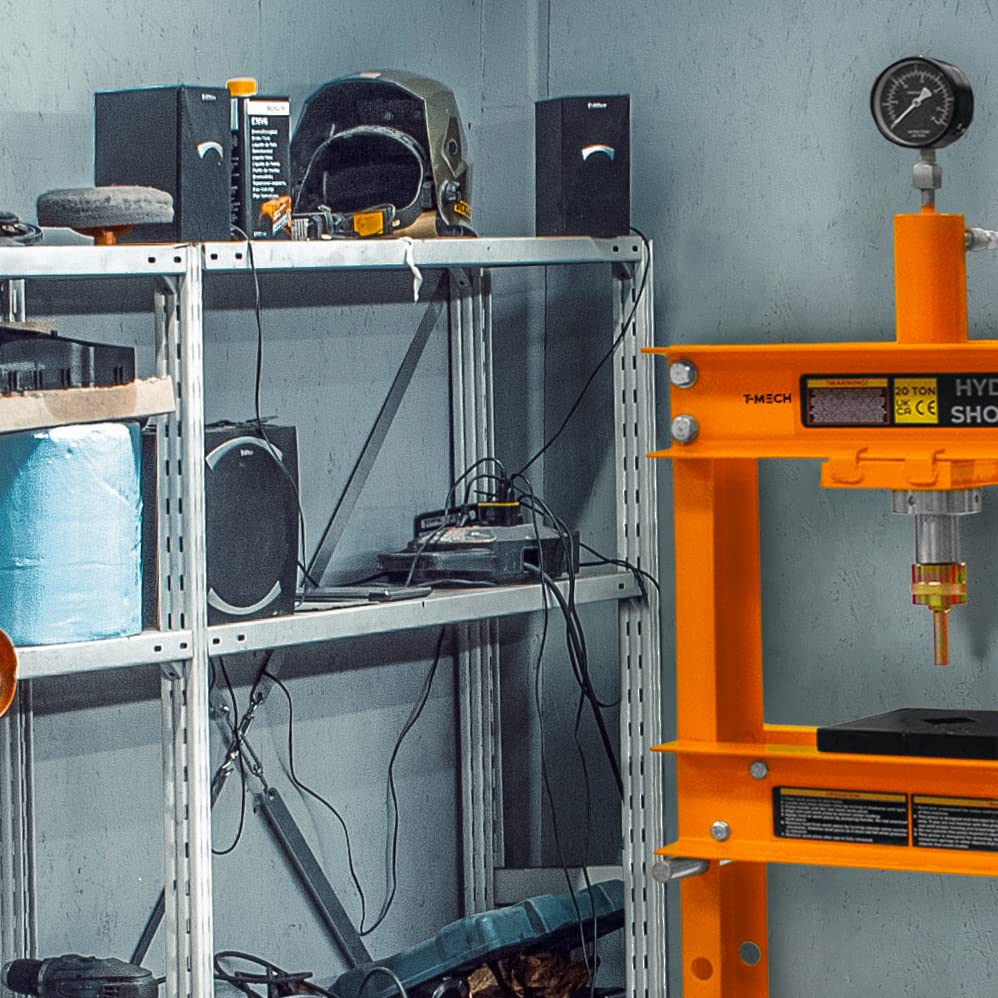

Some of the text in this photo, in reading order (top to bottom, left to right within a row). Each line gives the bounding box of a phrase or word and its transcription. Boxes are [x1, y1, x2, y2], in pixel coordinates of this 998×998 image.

[895, 386, 936, 396] 20 TON
[743, 393, 792, 404] T-MECH
